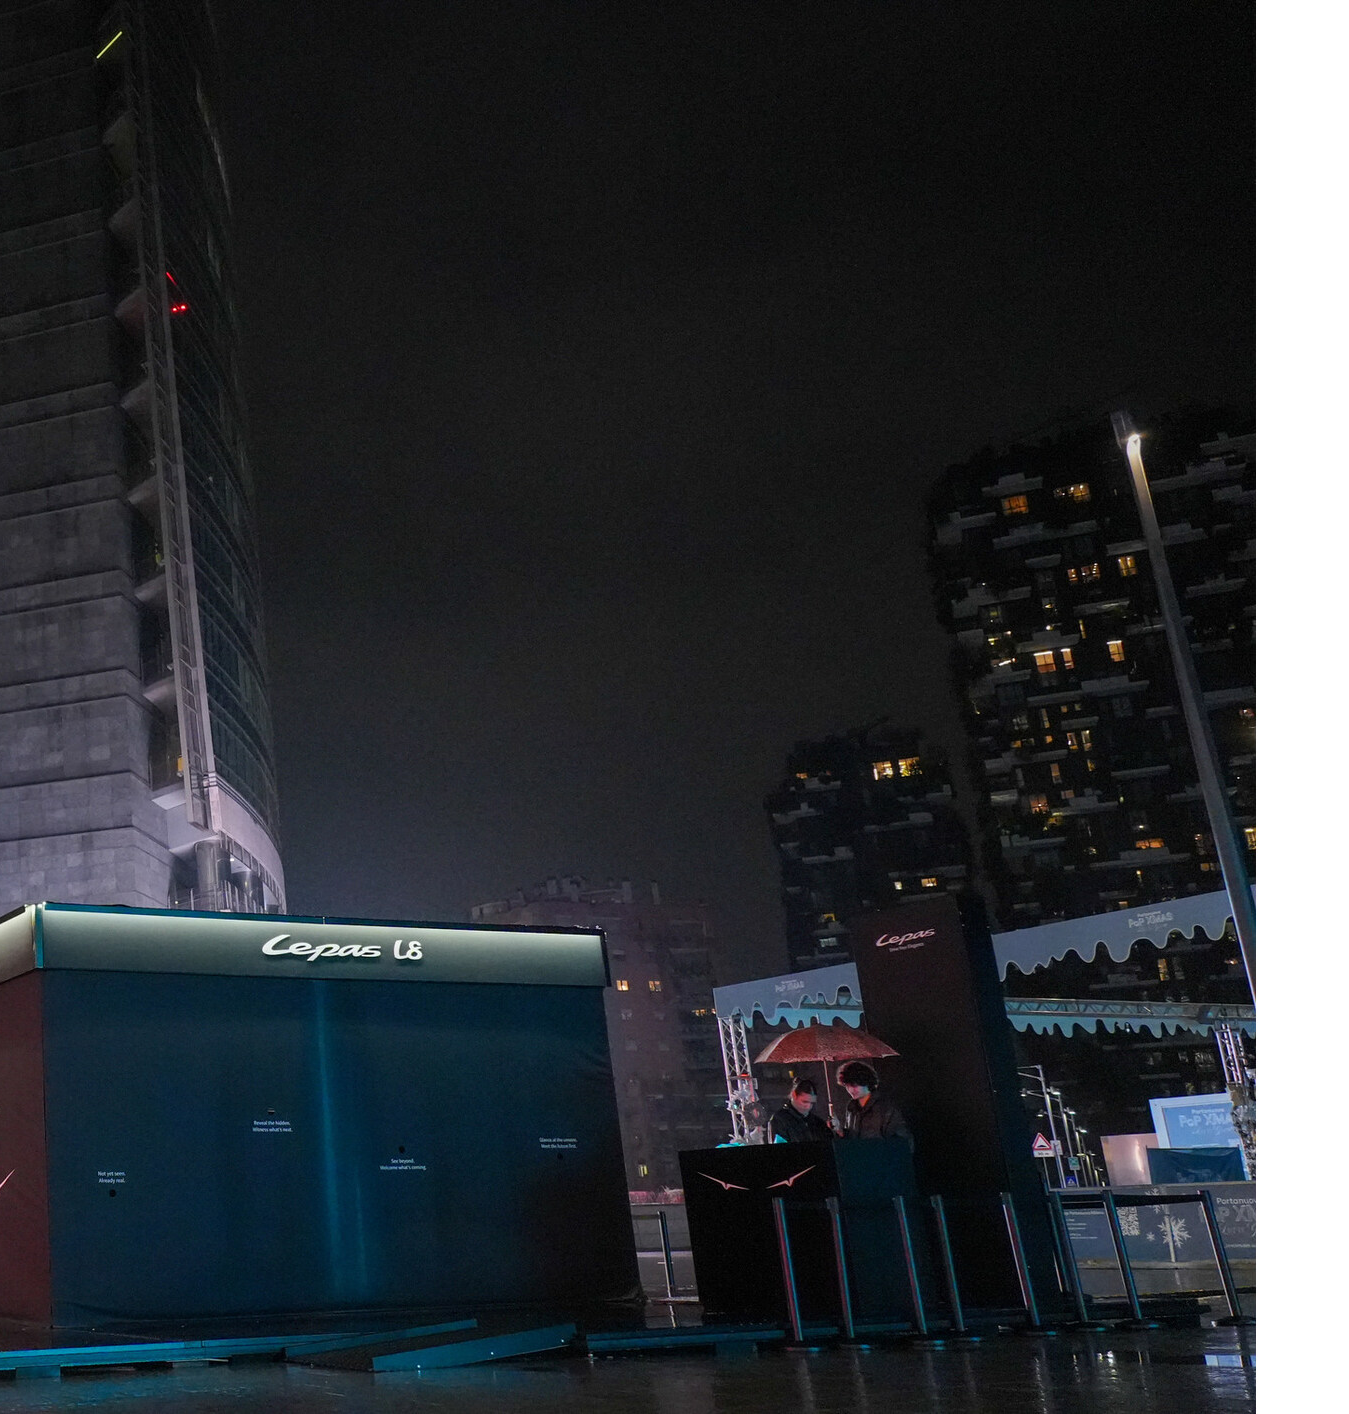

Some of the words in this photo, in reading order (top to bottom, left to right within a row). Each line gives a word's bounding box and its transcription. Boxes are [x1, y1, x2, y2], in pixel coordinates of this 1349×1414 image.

[261, 934, 382, 962] Lepas
[393, 939, 423, 960] L8
[876, 928, 936, 946] Lepas
